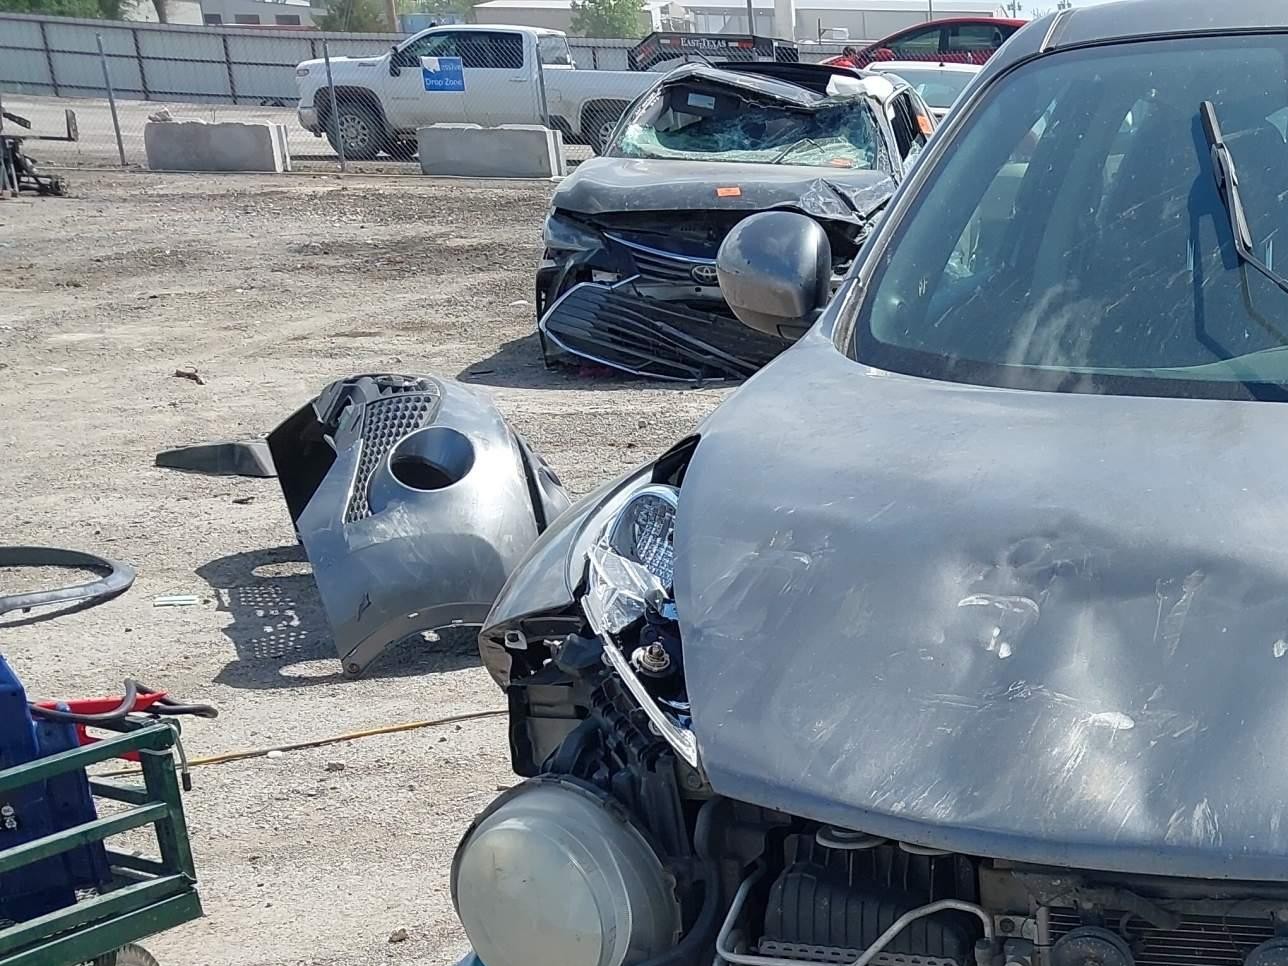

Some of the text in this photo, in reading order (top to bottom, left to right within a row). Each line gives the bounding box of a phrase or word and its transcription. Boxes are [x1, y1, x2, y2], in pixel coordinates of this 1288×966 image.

[680, 37, 699, 47] EAST
[425, 78, 463, 87] Drop Zone
